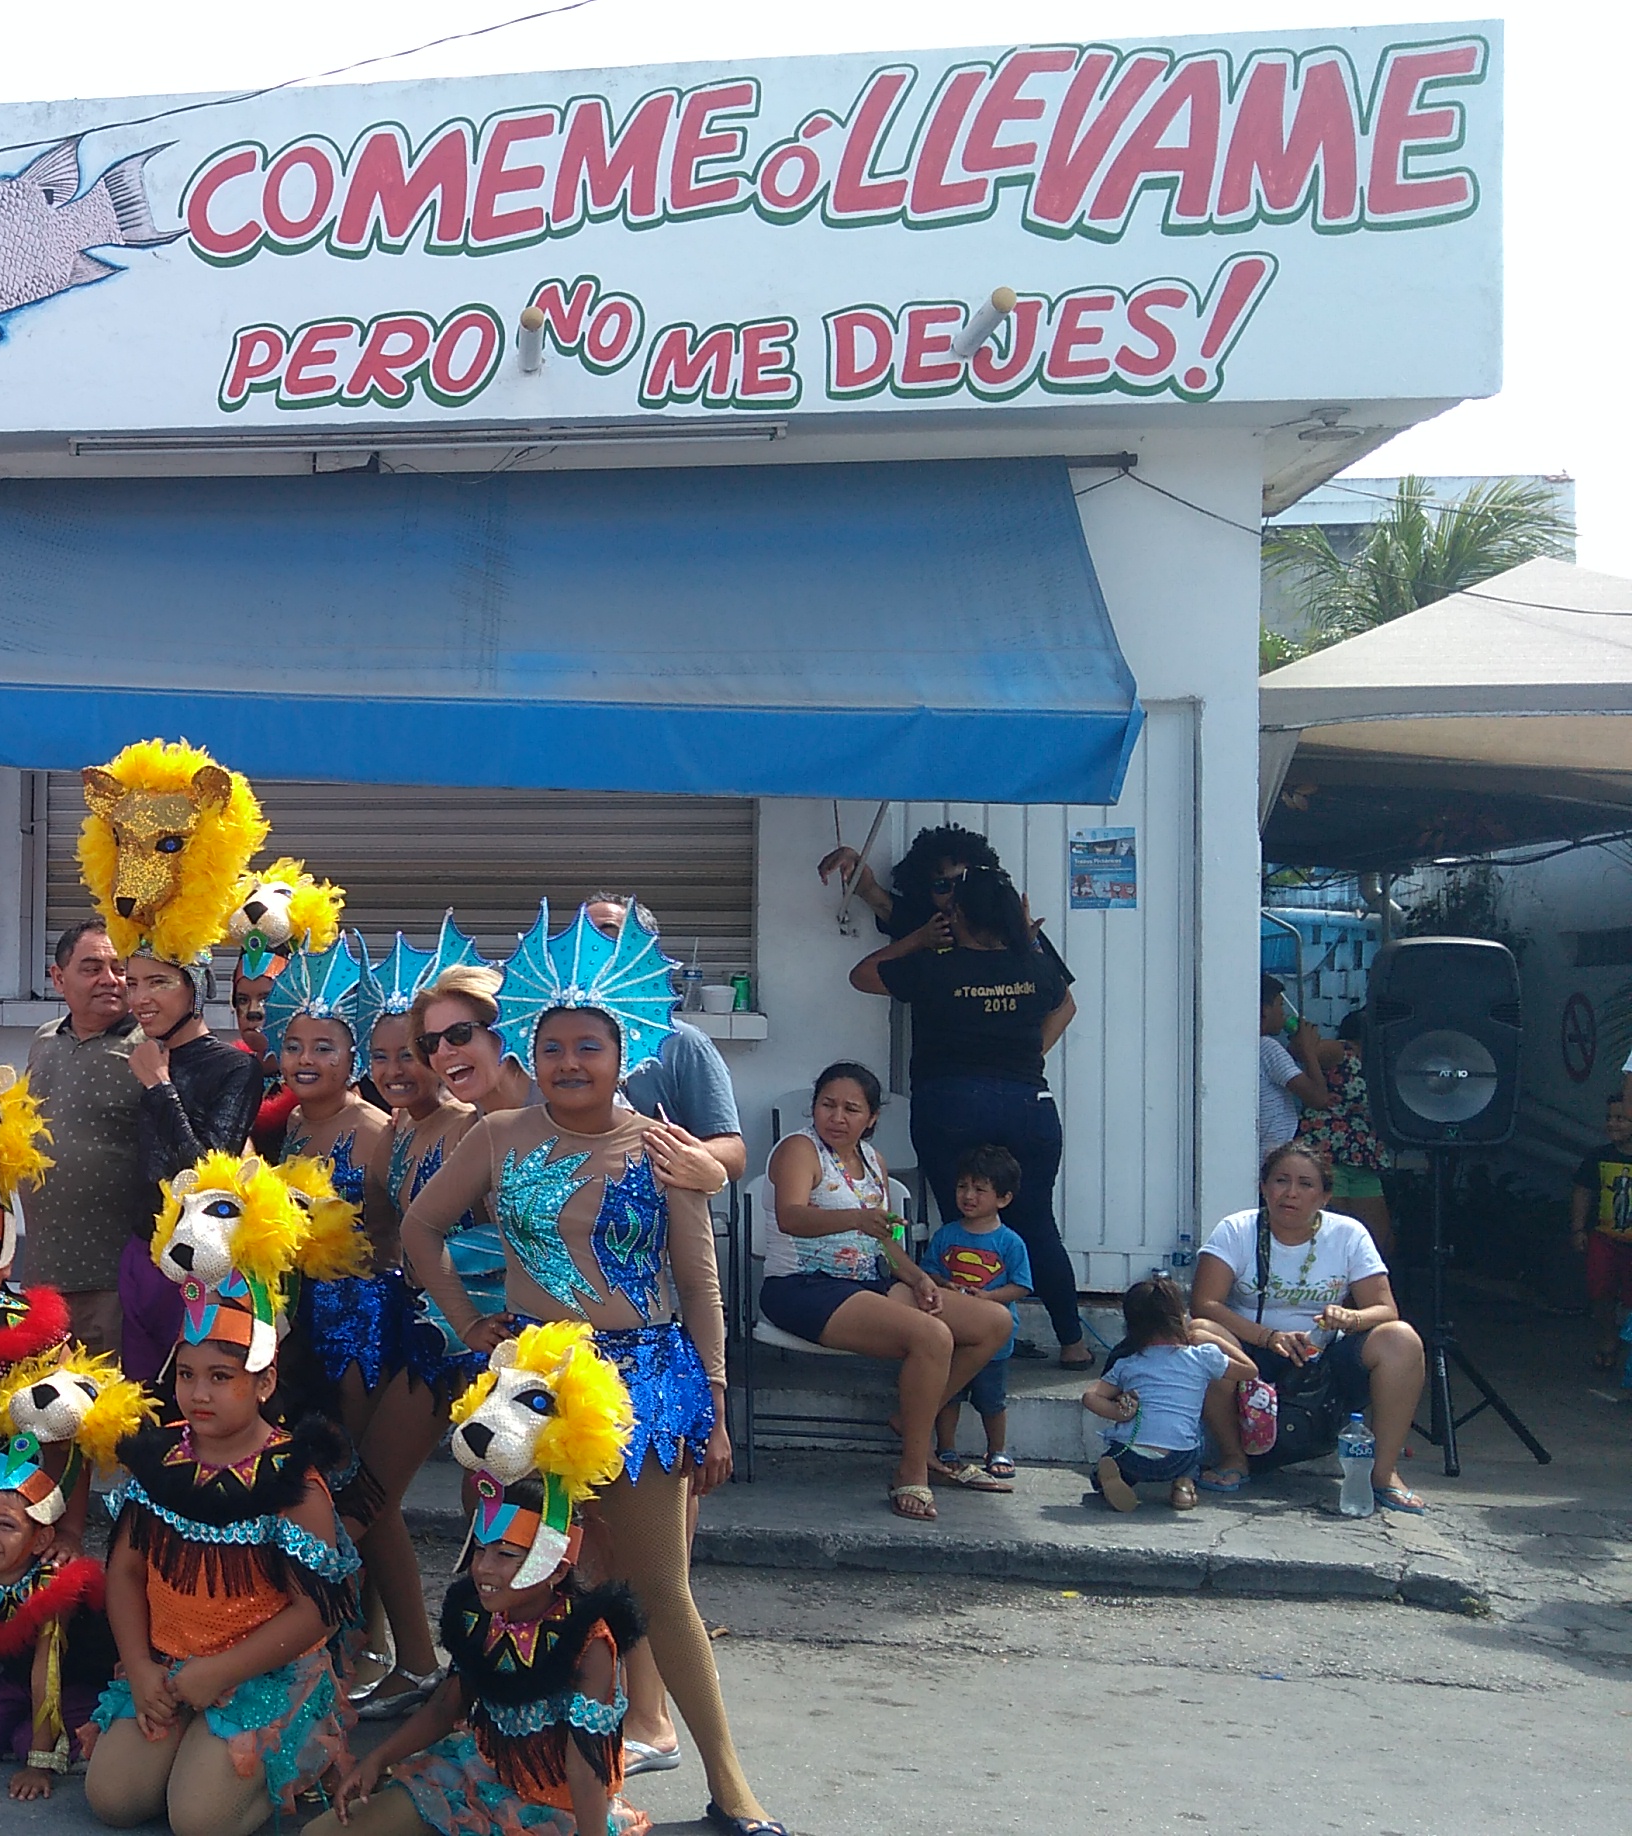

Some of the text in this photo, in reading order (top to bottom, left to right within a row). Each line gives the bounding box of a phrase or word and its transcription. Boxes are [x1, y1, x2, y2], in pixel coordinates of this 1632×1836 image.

[183, 77, 764, 268] COMEME
[813, 36, 1492, 242] LLEVAME
[219, 251, 1280, 410] PERO NO ME DEJES!
[984, 998, 1017, 1012] 2018
